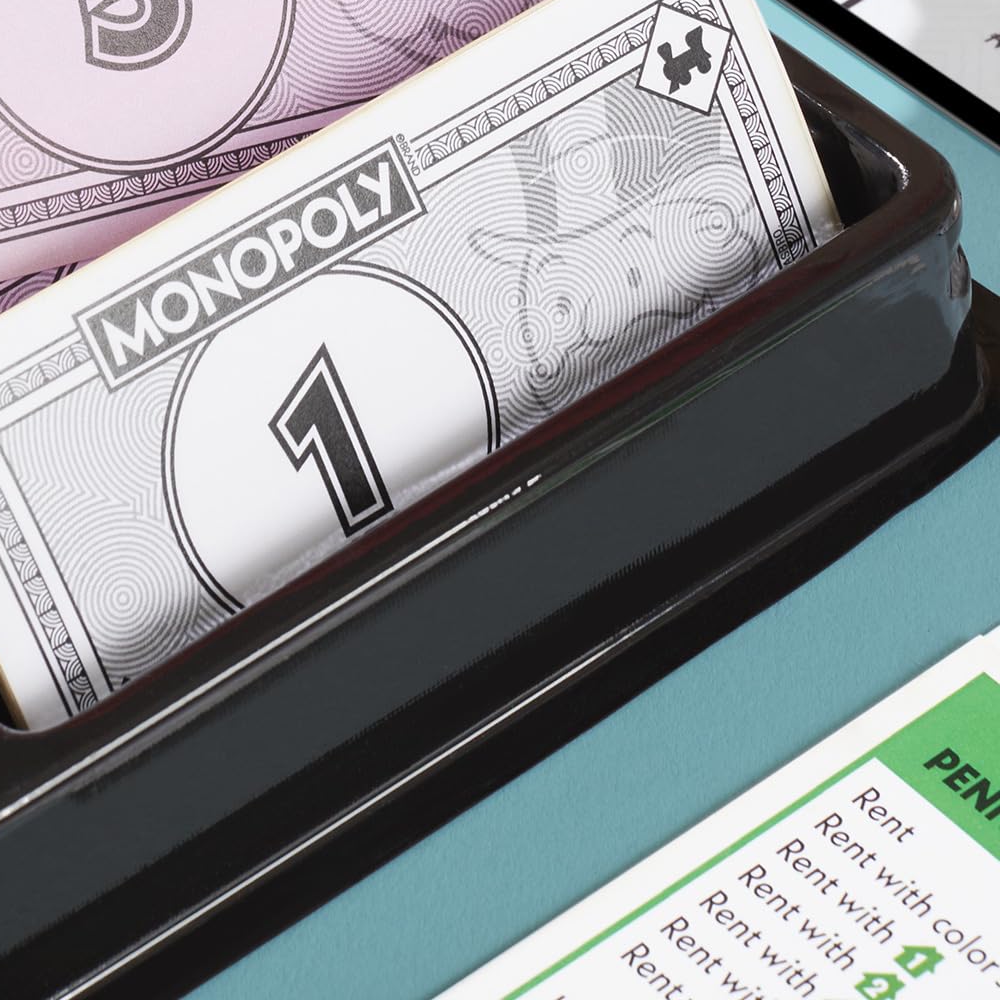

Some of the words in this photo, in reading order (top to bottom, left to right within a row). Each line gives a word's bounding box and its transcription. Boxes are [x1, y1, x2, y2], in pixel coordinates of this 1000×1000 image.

[101, 161, 395, 367] MONOPOLY
[268, 341, 395, 538] 1
[852, 786, 915, 843] Rent
[660, 916, 723, 974] Rent
[699, 889, 762, 948] Rent
[761, 945, 818, 998] with
[738, 863, 801, 921] Rent
[799, 918, 857, 972] with
[776, 838, 839, 895] Rent
[838, 892, 895, 945] with
[814, 812, 877, 869] Rent
[875, 866, 934, 918] with
[932, 918, 1000, 973] color
[620, 942, 684, 1000] Rent
